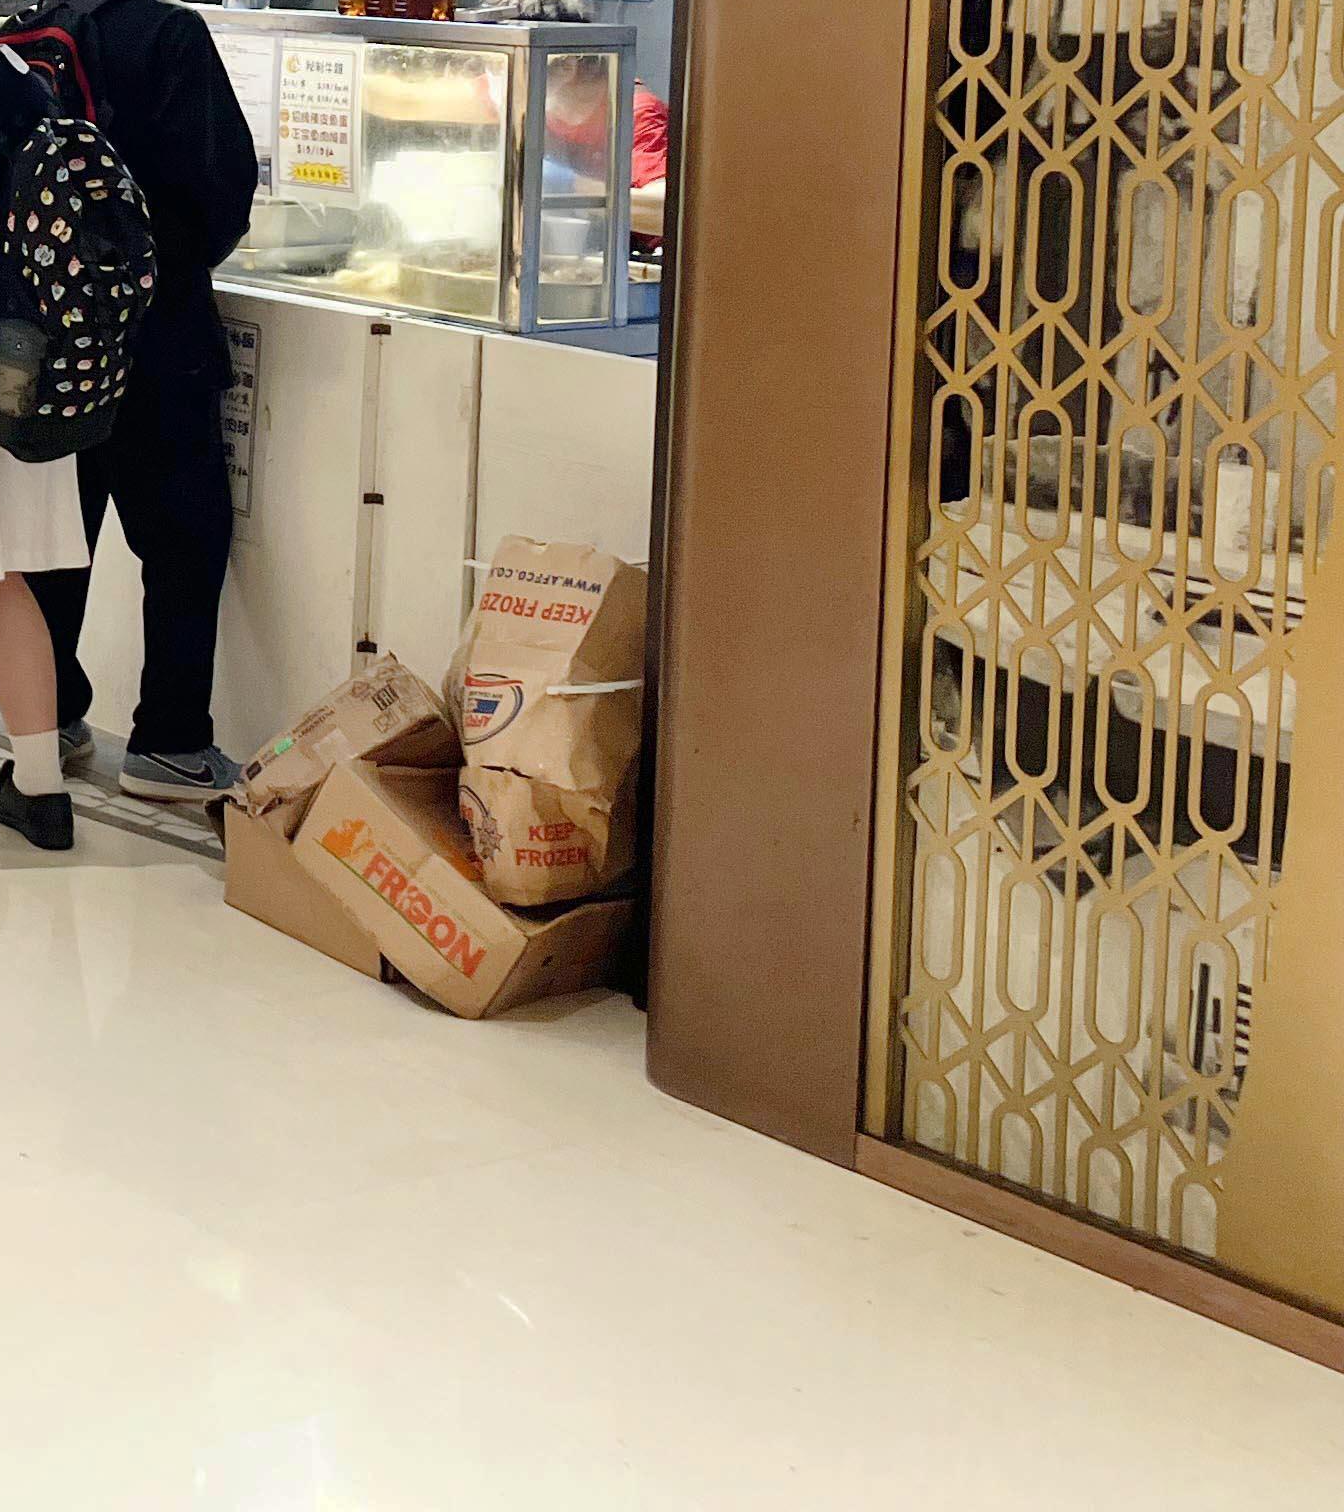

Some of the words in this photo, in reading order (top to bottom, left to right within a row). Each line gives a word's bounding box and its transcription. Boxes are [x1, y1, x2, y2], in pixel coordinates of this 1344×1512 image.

[541, 602, 593, 626] KEEP
[528, 821, 576, 841] KEEP
[515, 846, 591, 868] FROZEN
